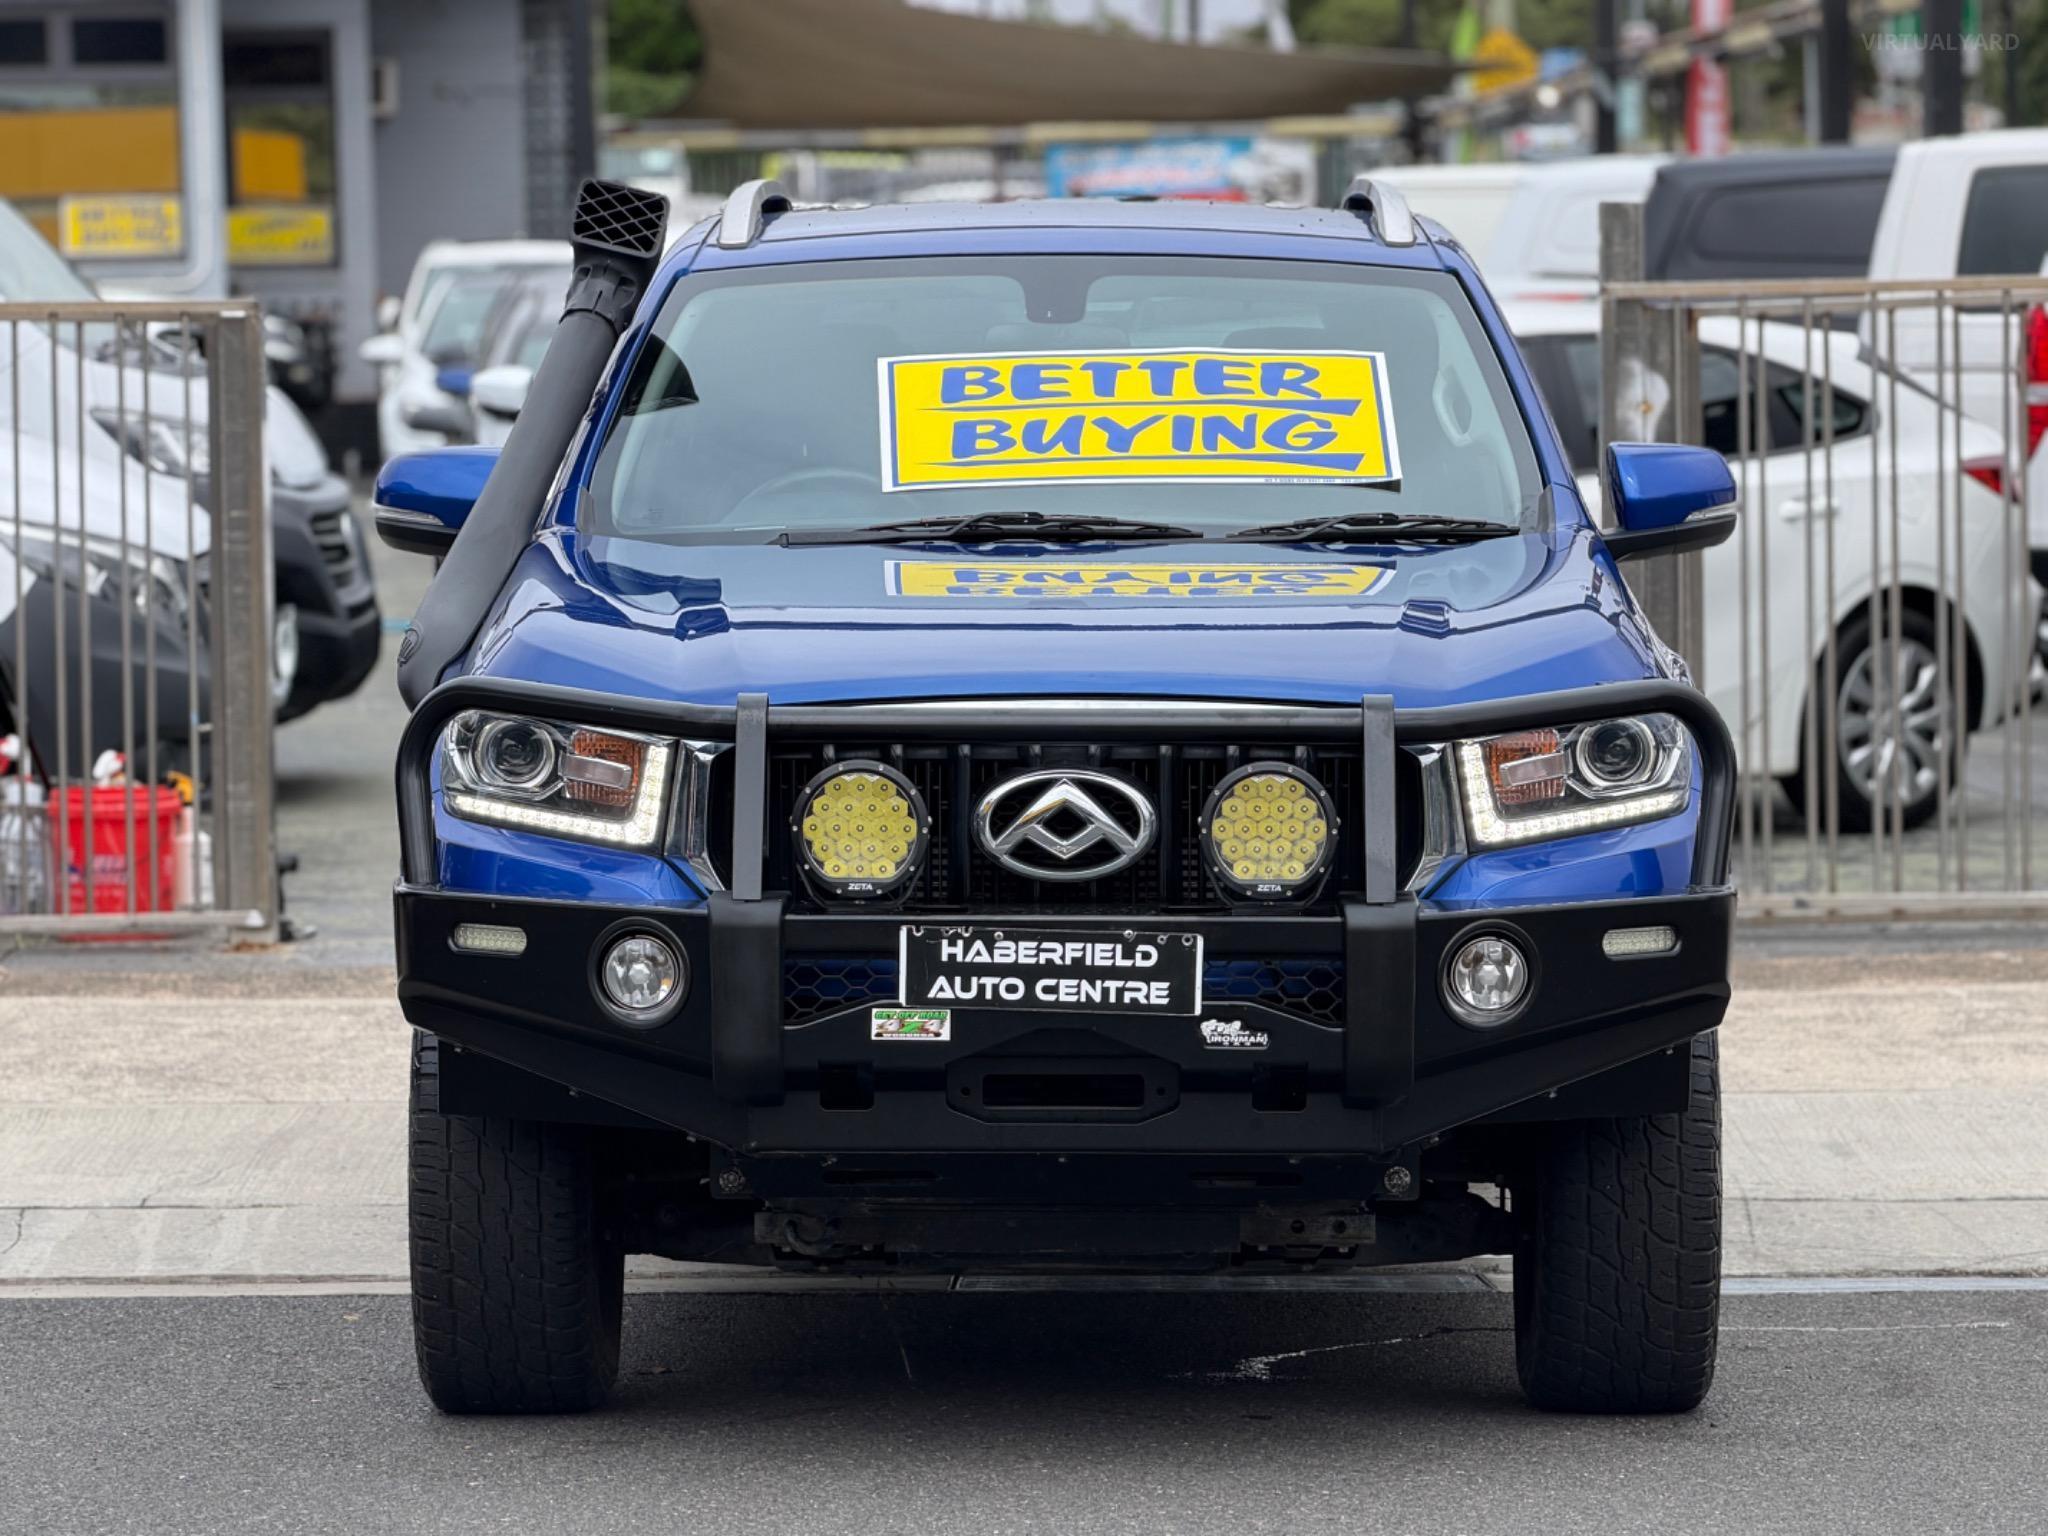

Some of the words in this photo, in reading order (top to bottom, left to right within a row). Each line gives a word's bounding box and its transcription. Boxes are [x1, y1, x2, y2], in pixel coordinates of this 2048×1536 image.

[940, 359, 1323, 404] BETTER
[942, 412, 1339, 459] BUYING
[1257, 884, 1282, 892] ZETA
[941, 939, 1159, 968] HABERFIELD
[927, 975, 1025, 1001] AUTO
[1035, 978, 1171, 1005] CENTRE
[1210, 1035, 1265, 1043] IRONMAN
